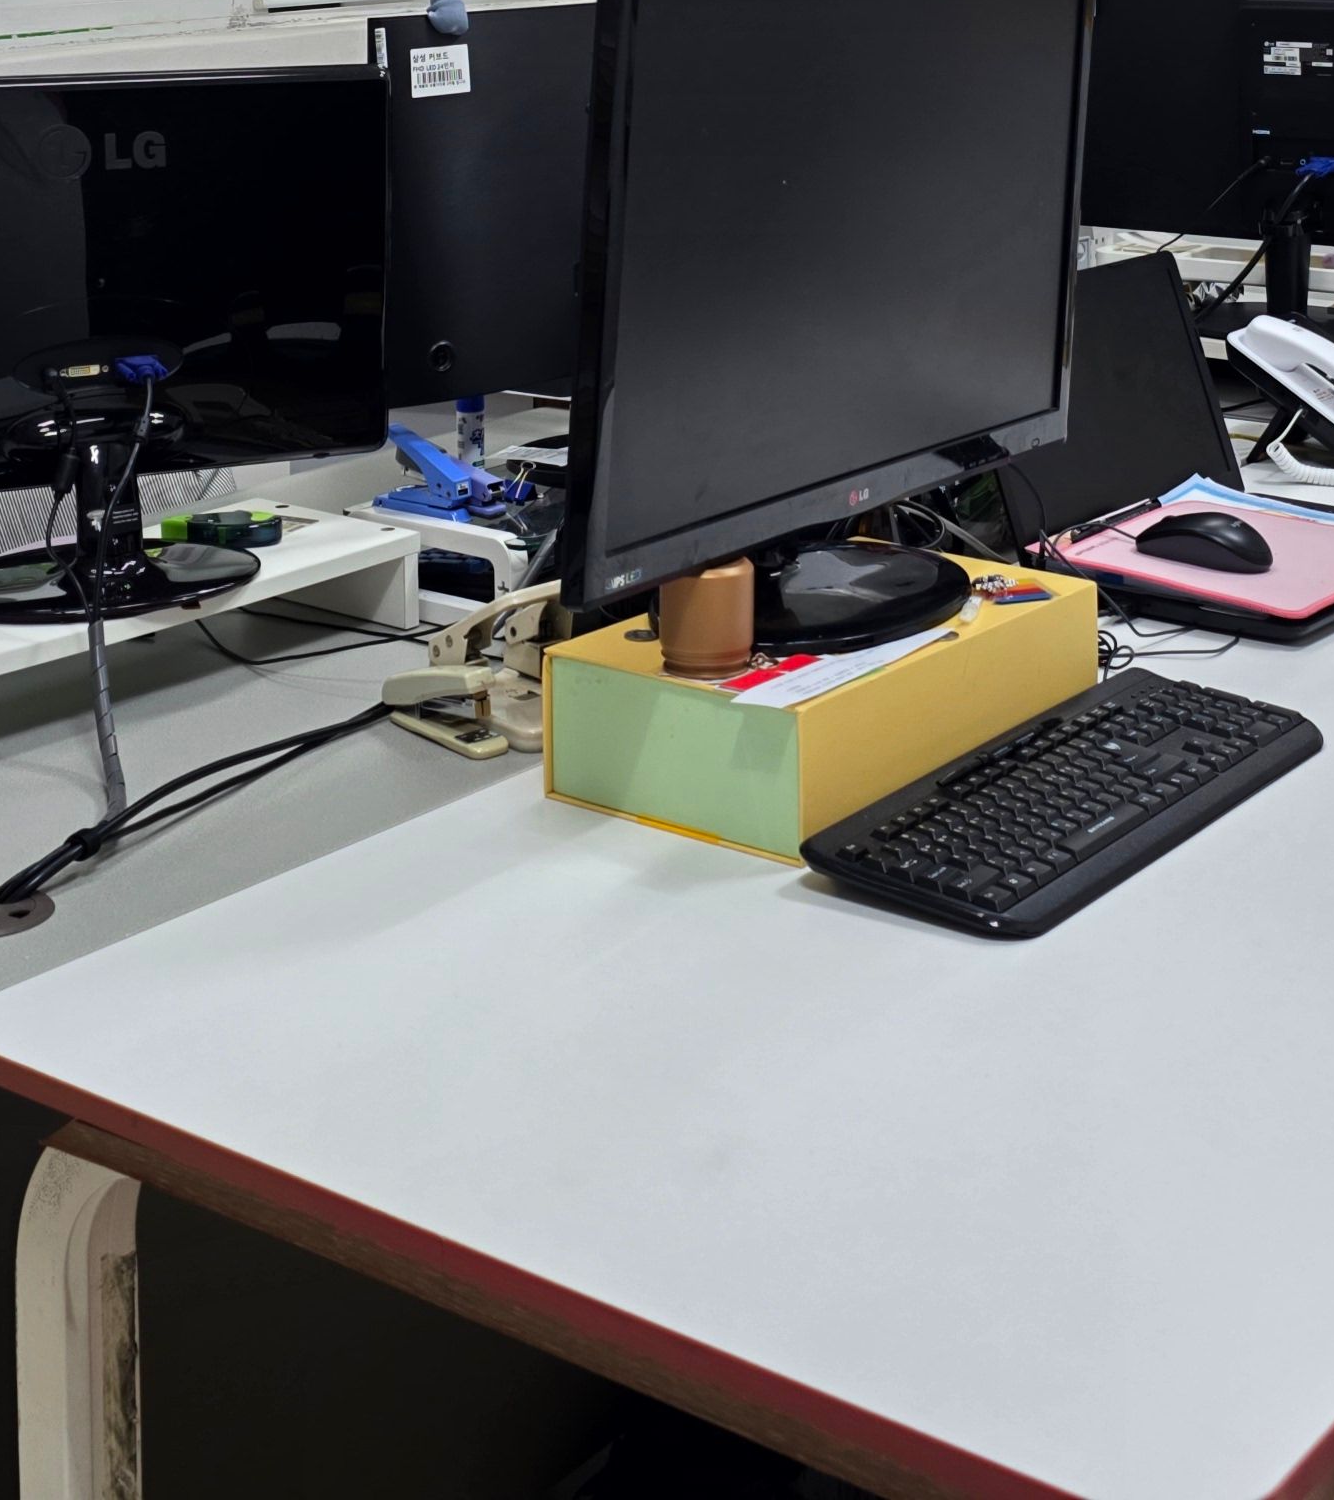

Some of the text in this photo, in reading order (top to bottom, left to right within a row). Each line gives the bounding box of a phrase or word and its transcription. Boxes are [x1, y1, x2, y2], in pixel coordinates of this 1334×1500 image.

[412, 53, 426, 63] 삼성
[104, 130, 167, 170] LG
[859, 488, 869, 501] LG
